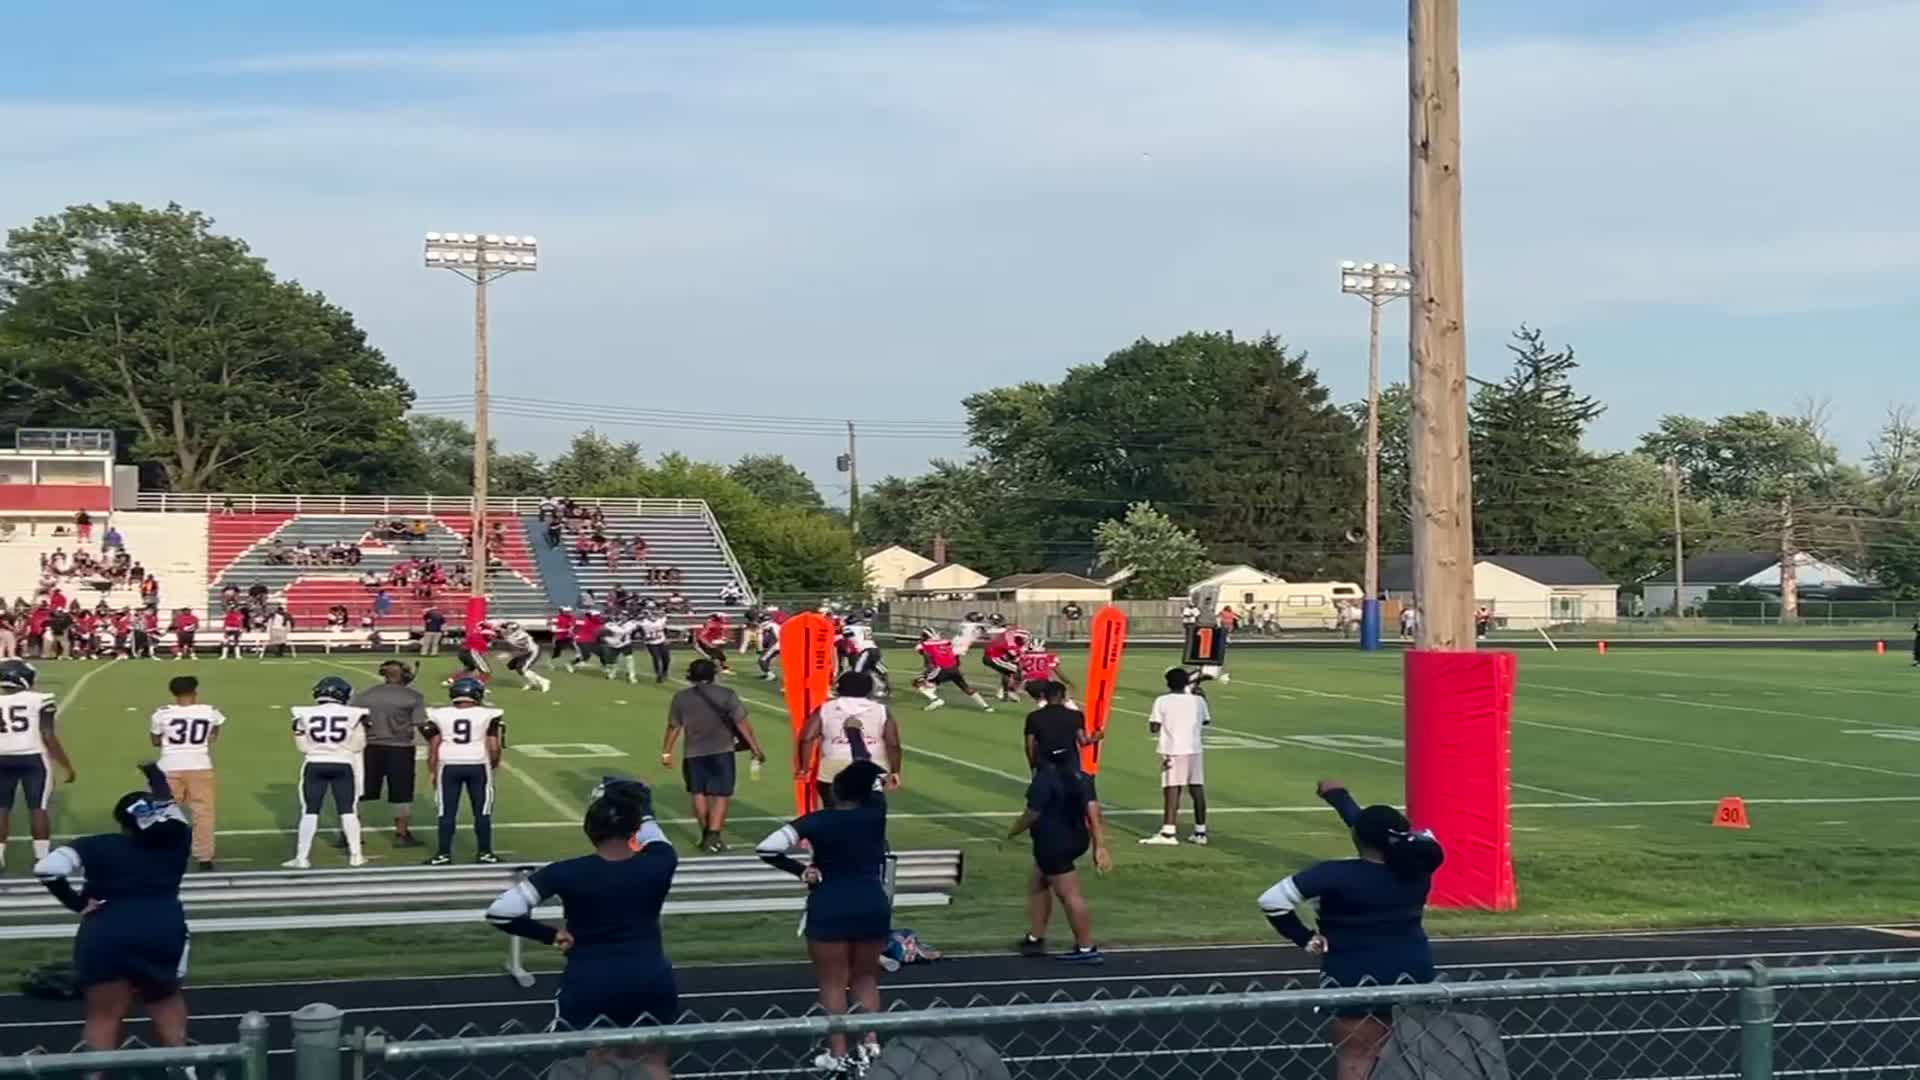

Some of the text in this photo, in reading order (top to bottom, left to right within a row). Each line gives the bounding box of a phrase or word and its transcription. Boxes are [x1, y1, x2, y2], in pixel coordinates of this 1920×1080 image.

[1198, 627, 1213, 658] 1
[168, 718, 210, 745] 30
[309, 716, 348, 743] 25
[453, 719, 471, 744] 9
[1720, 807, 1740, 823] 30
